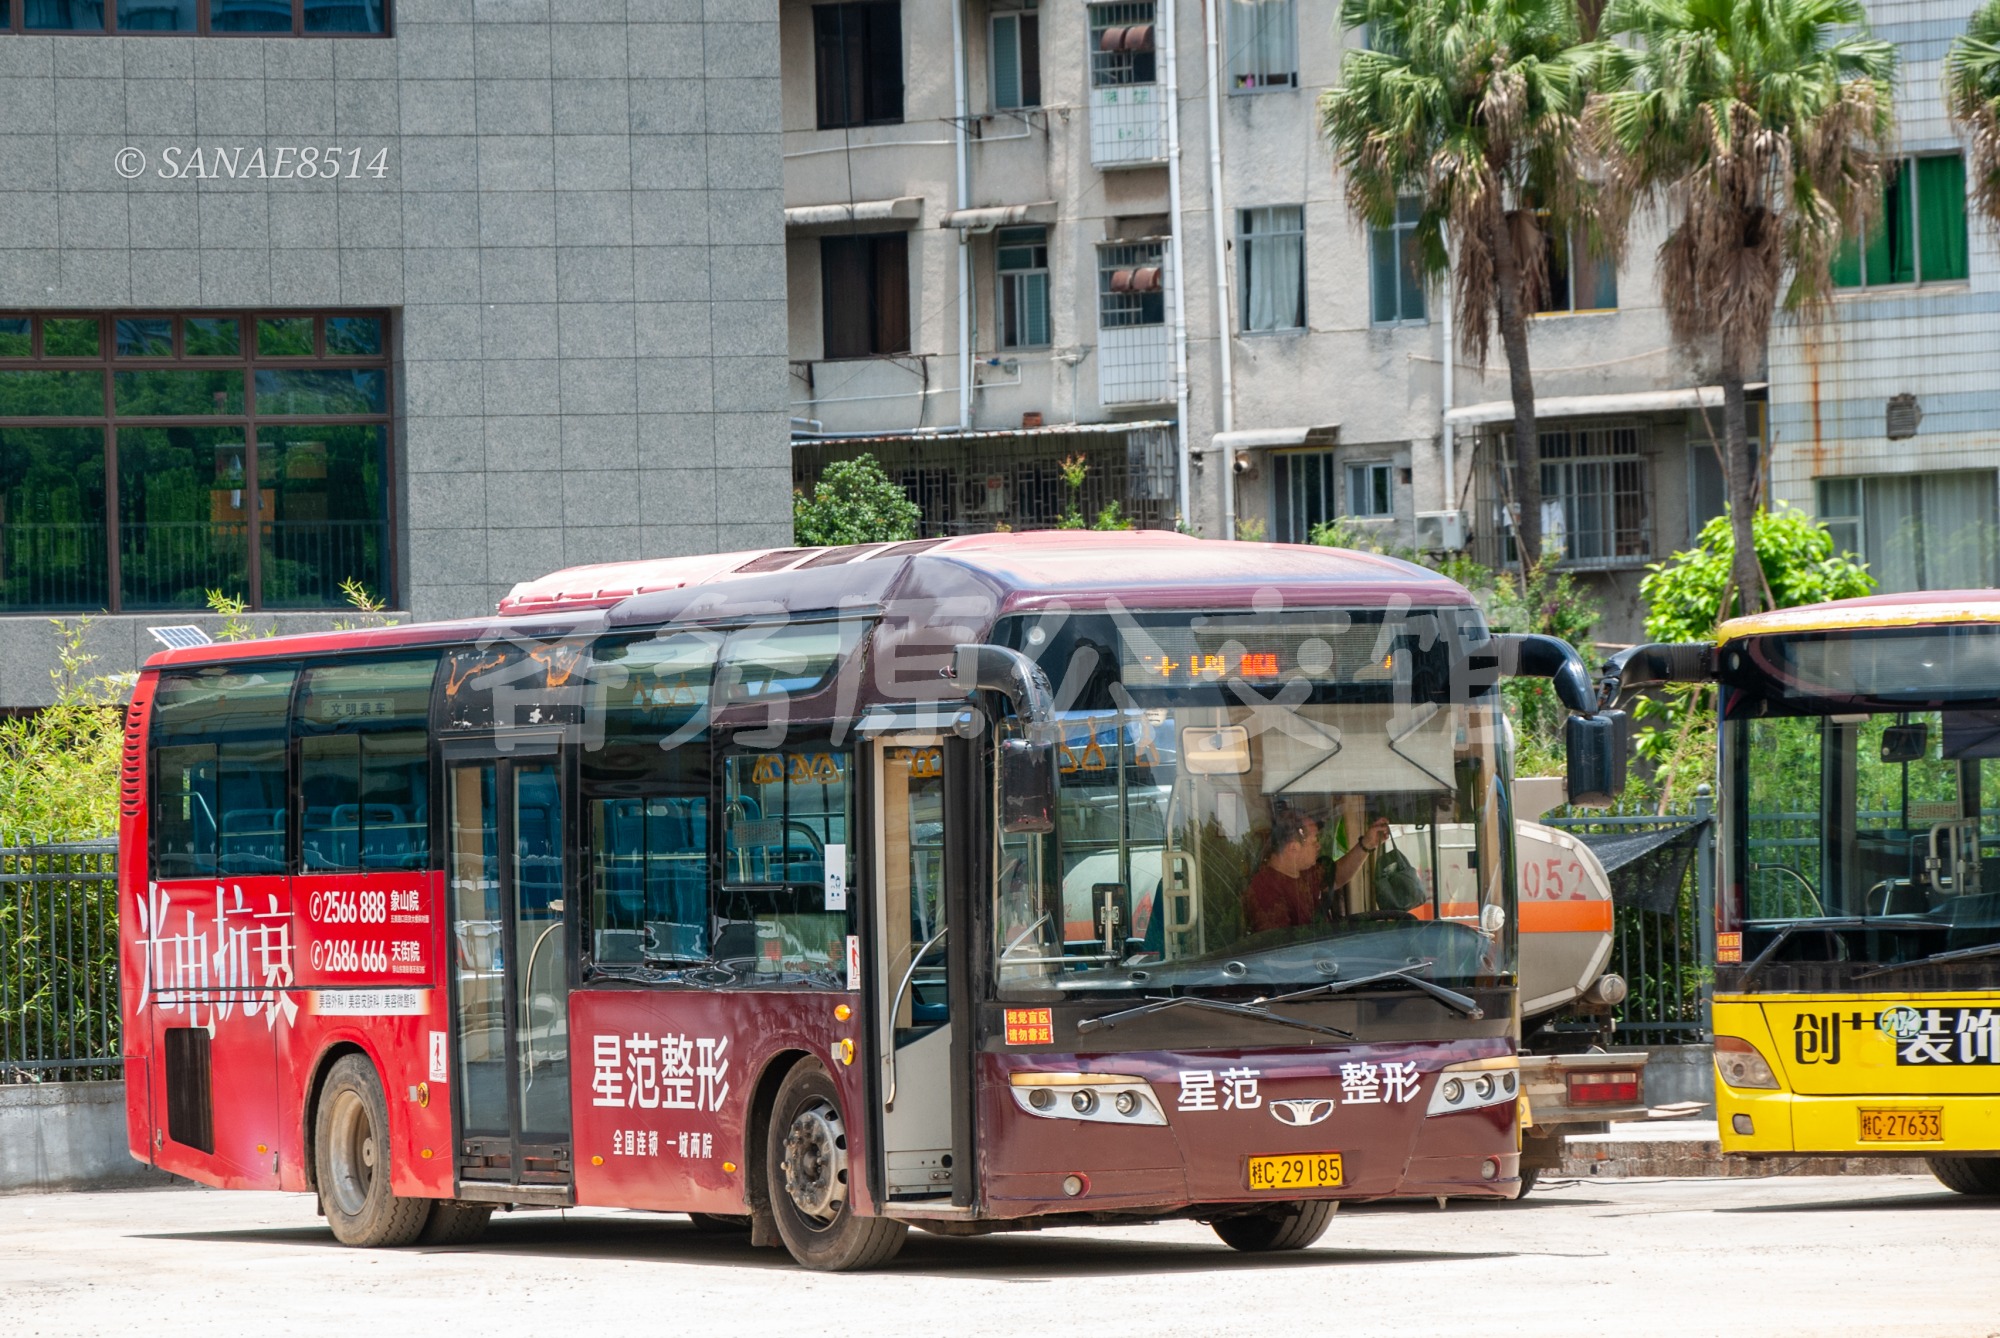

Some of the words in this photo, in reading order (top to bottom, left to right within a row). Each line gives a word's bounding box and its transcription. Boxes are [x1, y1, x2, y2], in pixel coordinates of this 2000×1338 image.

[331, 702, 386, 716] 文明乘车
[323, 891, 357, 923] 2566
[359, 891, 386, 923] 888
[390, 889, 419, 912] 象山院
[324, 939, 358, 972] 2686
[361, 940, 387, 973] 666
[391, 941, 420, 963] 天街院
[1007, 1011, 1049, 1025] 视觉盲区
[1008, 1028, 1049, 1042] 请勿靠近
[591, 1032, 730, 1113] 星范整形
[1177, 1066, 1263, 1114] 星范
[1338, 1060, 1421, 1106] 整形
[612, 1129, 659, 1158] 全国连锁
[666, 1131, 713, 1159] 一城两院
